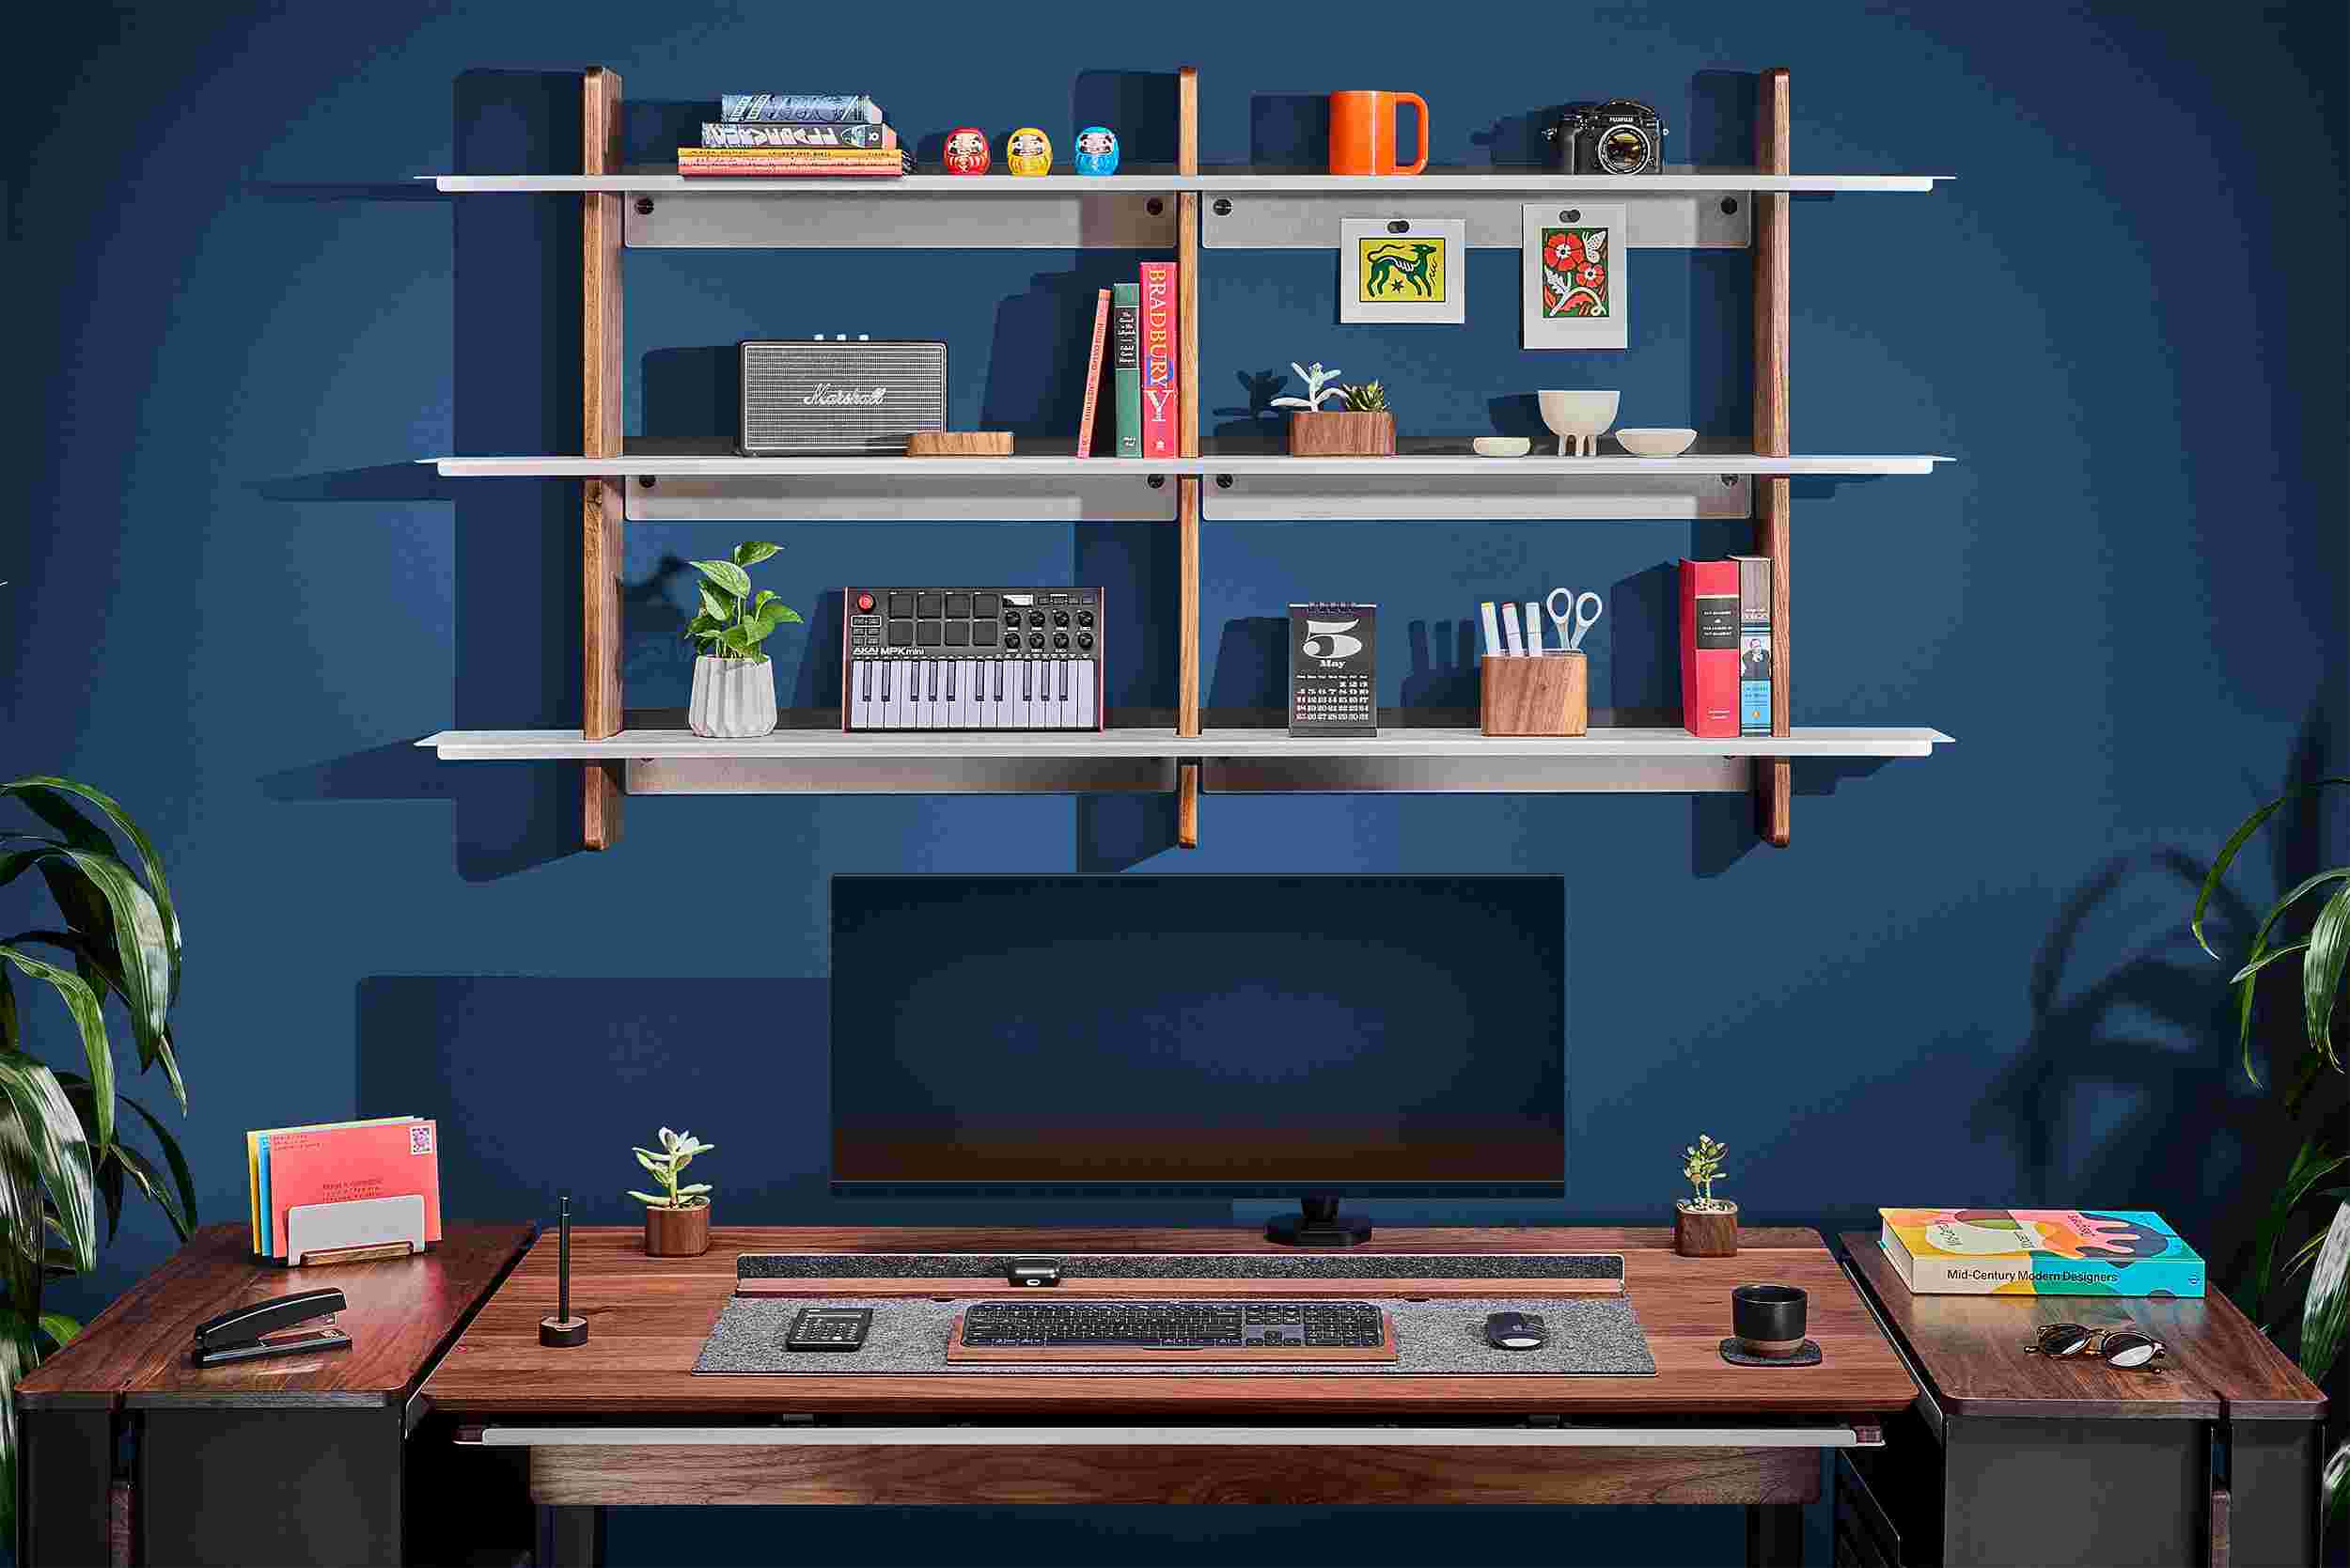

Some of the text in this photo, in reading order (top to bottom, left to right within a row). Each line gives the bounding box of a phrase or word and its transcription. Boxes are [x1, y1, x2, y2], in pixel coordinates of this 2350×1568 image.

[1149, 269, 1167, 388] BRADBURY
[803, 383, 887, 405] Marshall
[1303, 619, 1362, 659] 5
[1319, 659, 1347, 669] May
[1947, 1269, 2118, 1283] Mid-Century Modern Designers
